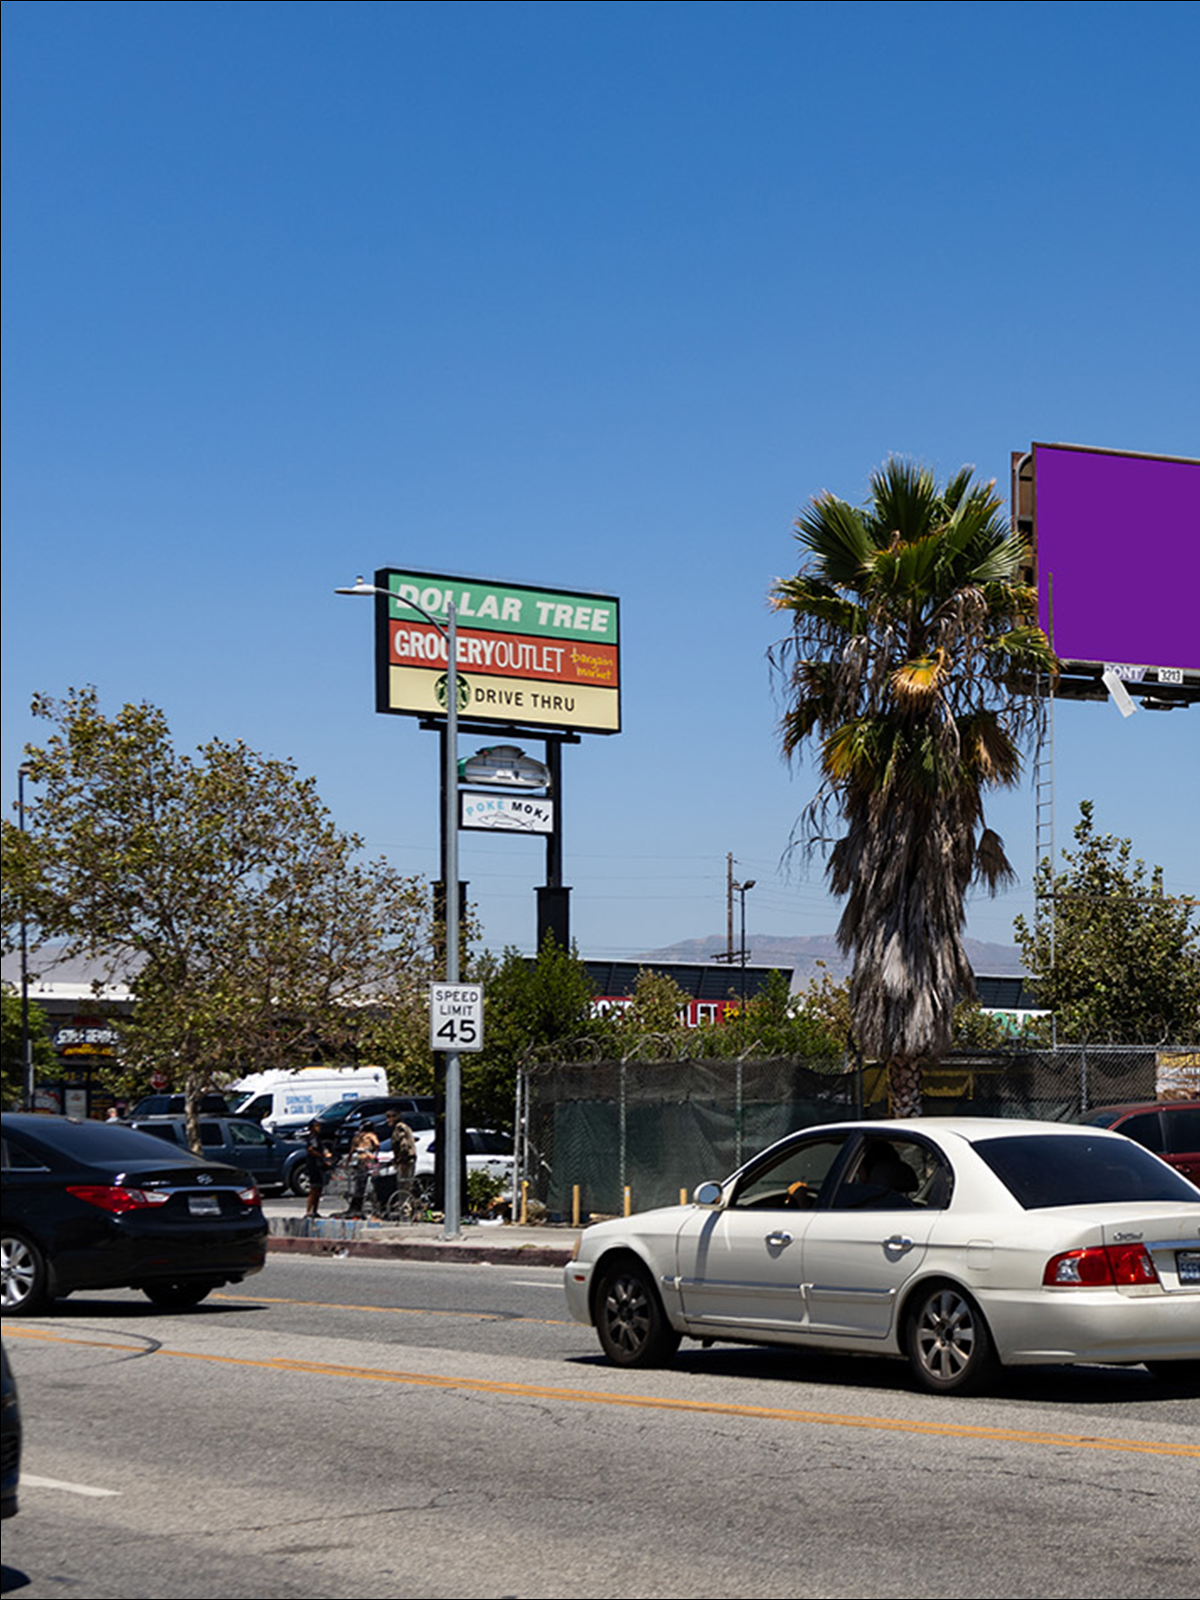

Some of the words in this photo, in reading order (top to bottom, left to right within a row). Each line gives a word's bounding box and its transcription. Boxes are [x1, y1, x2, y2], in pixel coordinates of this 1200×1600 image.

[396, 584, 523, 622] DOLLAR
[536, 600, 610, 632] TREE
[569, 647, 613, 670] bargain
[577, 667, 611, 680] market
[475, 688, 523, 706] DRIVE
[531, 694, 575, 712] THRU
[511, 802, 550, 822] MOKI
[436, 990, 479, 1003] SPEED
[440, 1005, 473, 1016] LIMIT
[437, 1019, 477, 1043] 45
